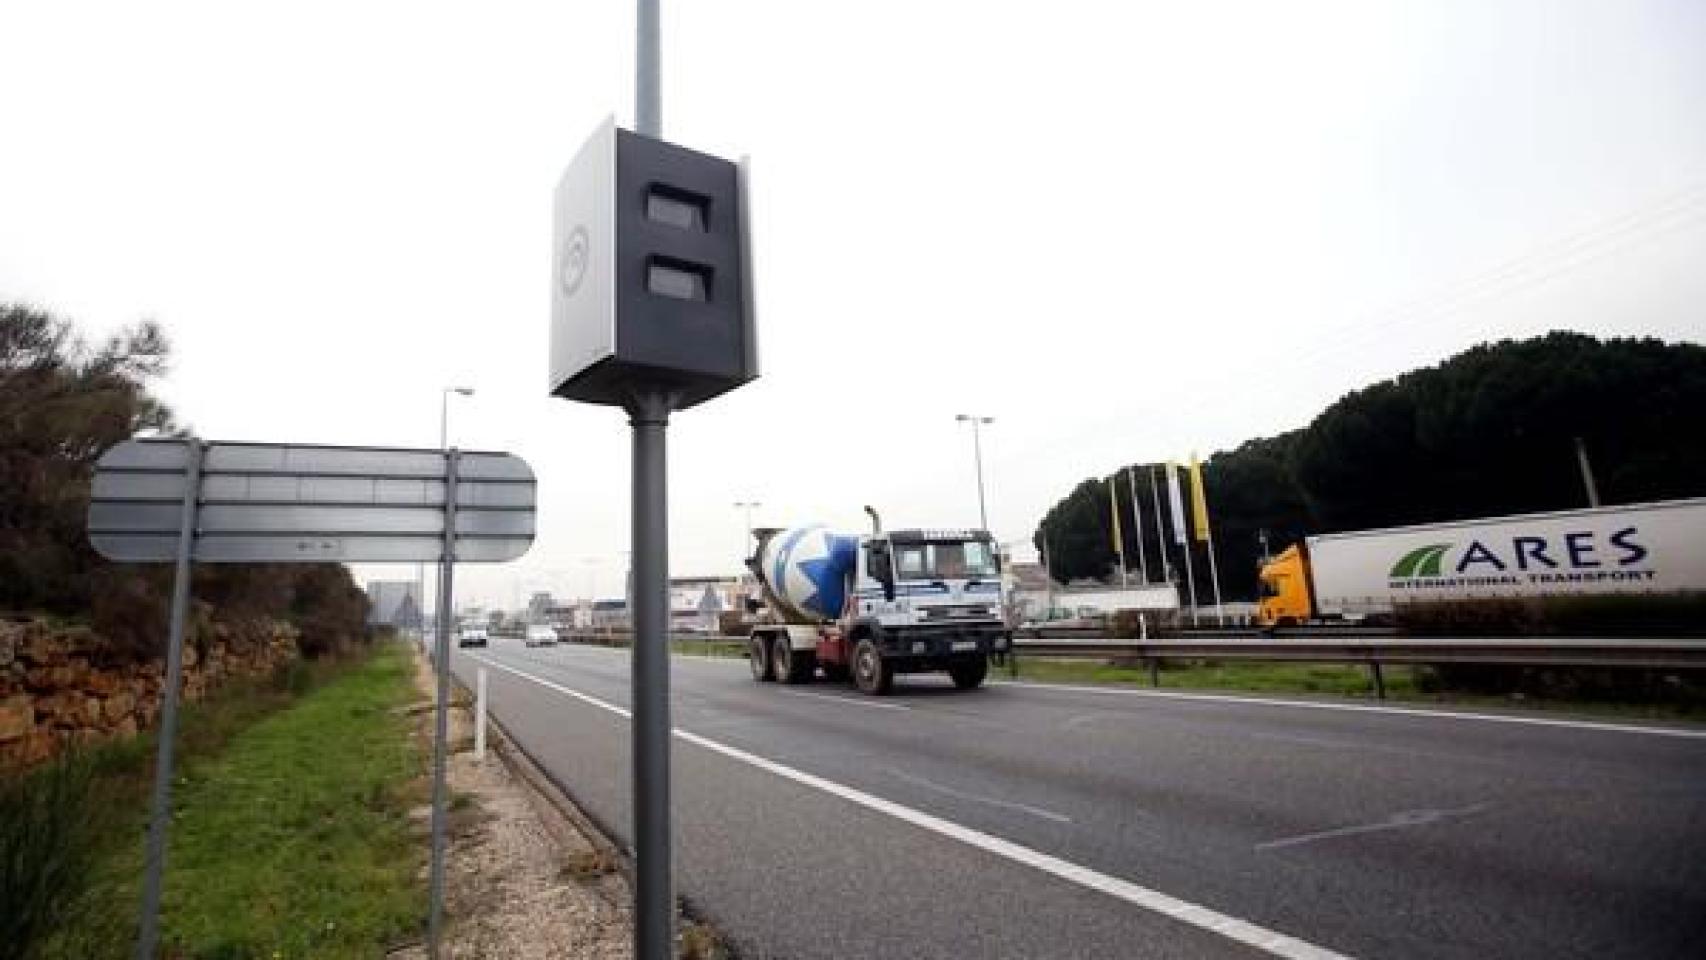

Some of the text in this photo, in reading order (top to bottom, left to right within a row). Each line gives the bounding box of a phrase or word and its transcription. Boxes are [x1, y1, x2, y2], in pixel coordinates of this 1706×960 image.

[1456, 526, 1648, 573] ARES
[1389, 570, 1656, 589] INTERNATIONAL TRANSPORT
